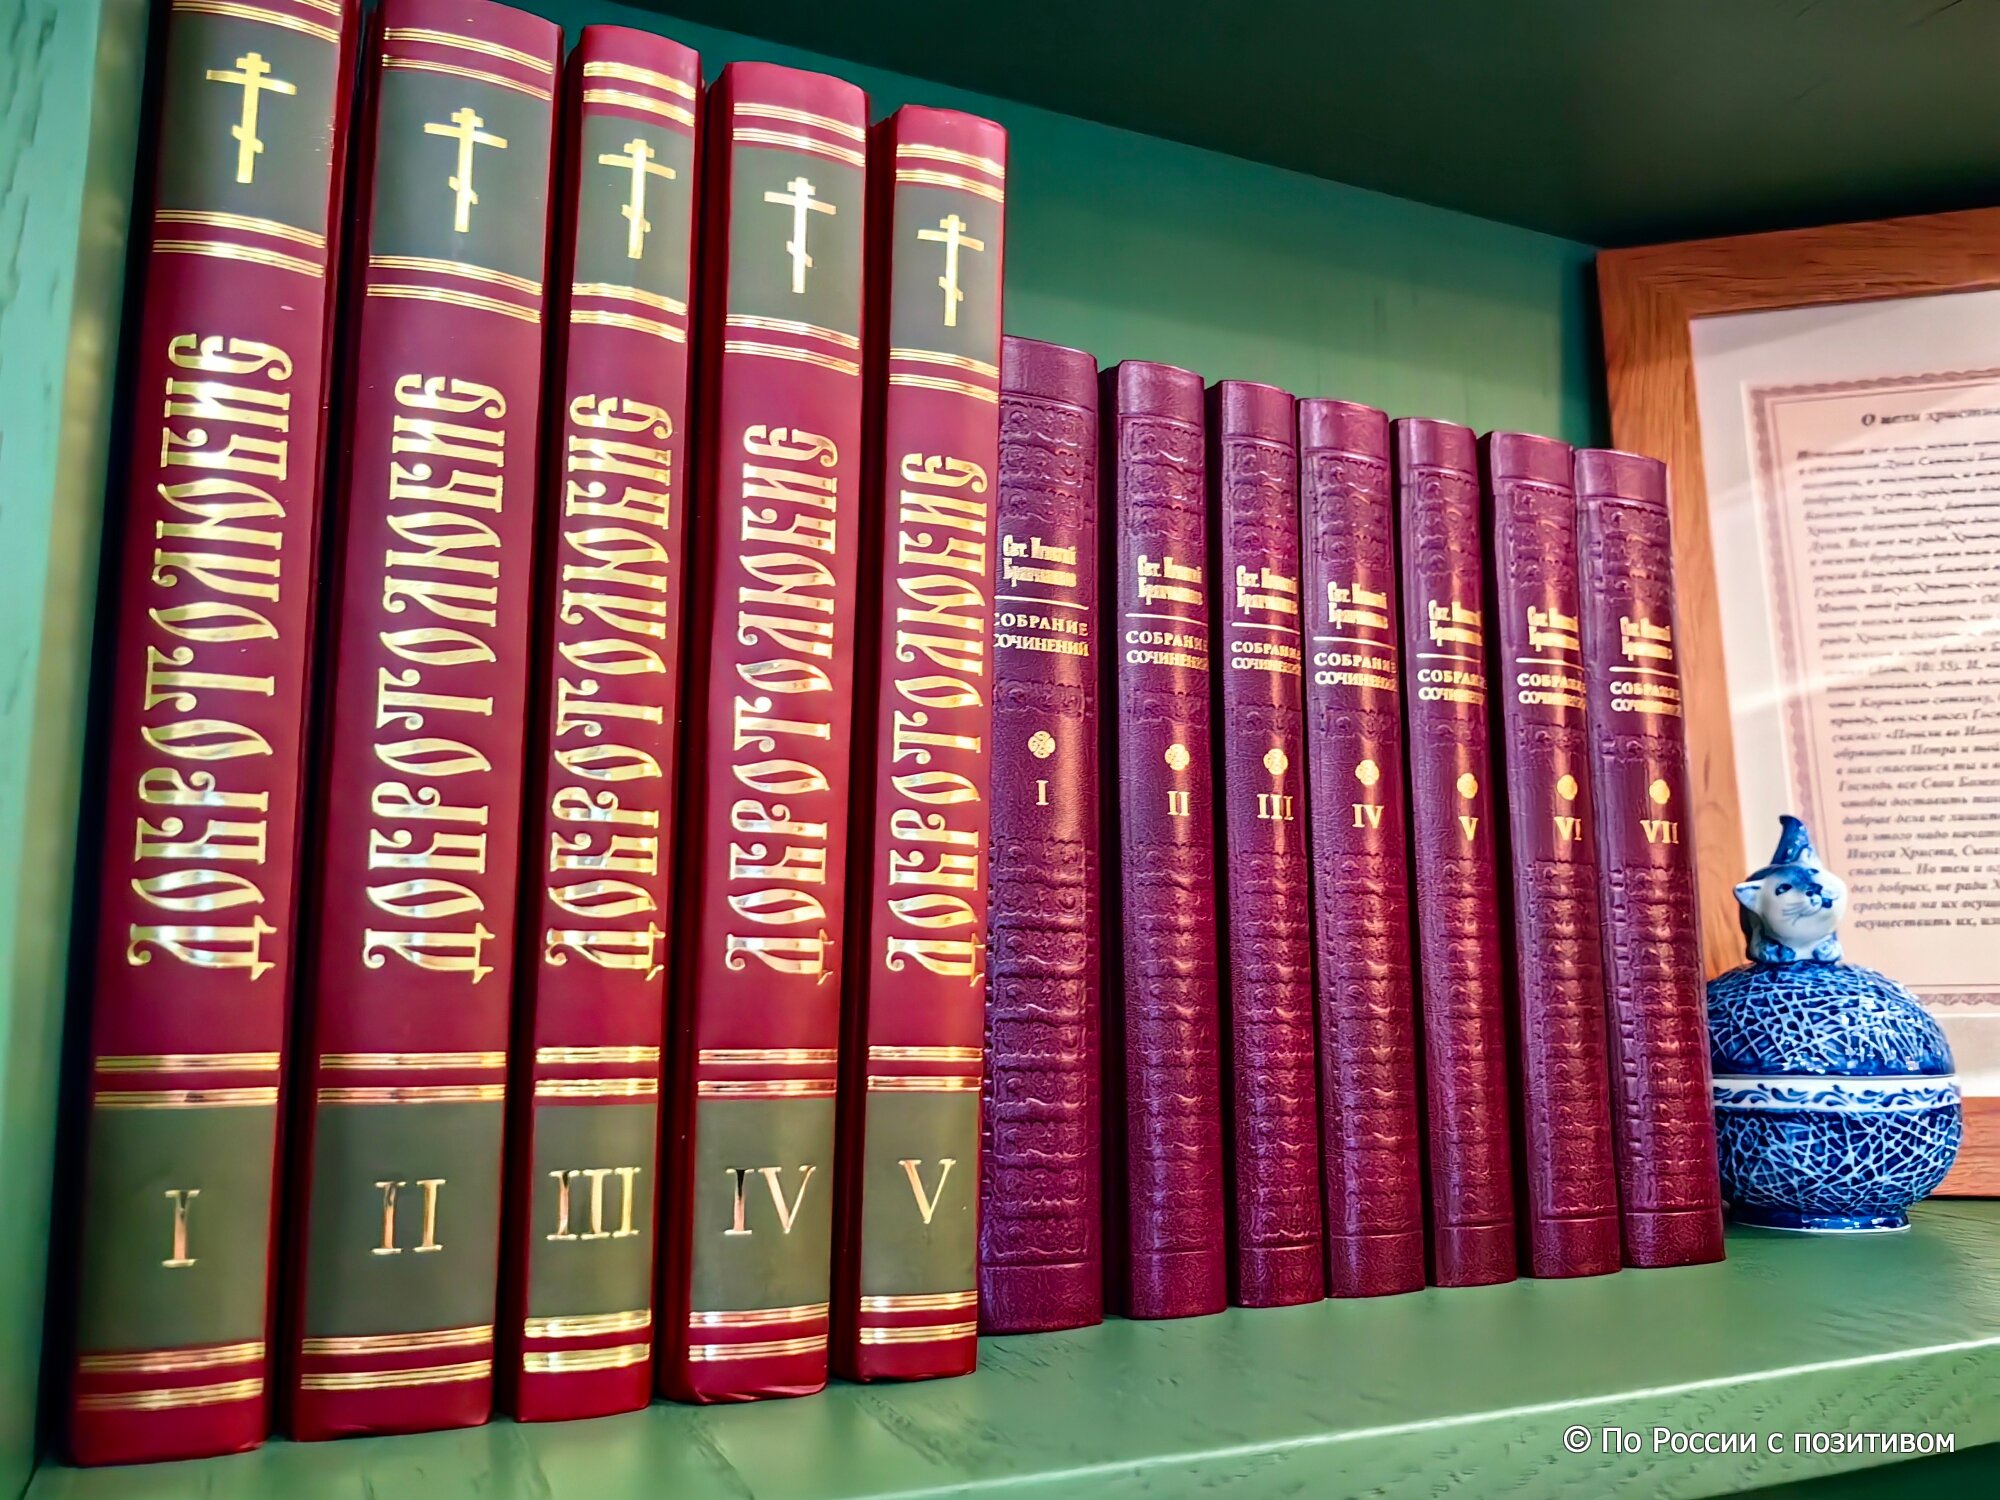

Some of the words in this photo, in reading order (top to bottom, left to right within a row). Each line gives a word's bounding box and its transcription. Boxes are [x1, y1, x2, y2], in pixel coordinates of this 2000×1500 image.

[1035, 780, 1049, 805] I
[1838, 780, 1893, 792] Господь
[1166, 790, 1190, 816] II
[1257, 793, 1294, 821] III
[1351, 802, 1384, 829] IV
[1458, 815, 1479, 841] V
[1554, 815, 1582, 841] VI
[1896, 813, 1925, 823] дела
[1640, 818, 1680, 845] VII
[1916, 830, 1948, 840] надо
[1847, 848, 1896, 861] Иисуса
[1900, 846, 1958, 861] Христа,
[1916, 863, 1936, 874] Но
[1940, 865, 1970, 873] тем
[1851, 884, 1873, 893] дел
[1877, 881, 1931, 894] добрых,
[1954, 881, 1988, 893] ради
[1853, 901, 1917, 913] средства
[1920, 901, 1937, 909] на
[1941, 901, 1957, 909] их
[1854, 917, 1951, 930] осуществить
[1956, 916, 1977, 927] их,
[546, 1166, 641, 1241] III
[723, 1165, 817, 1236] IV
[898, 1158, 957, 1225] V
[162, 1189, 200, 1269] I
[371, 1178, 446, 1255] II
